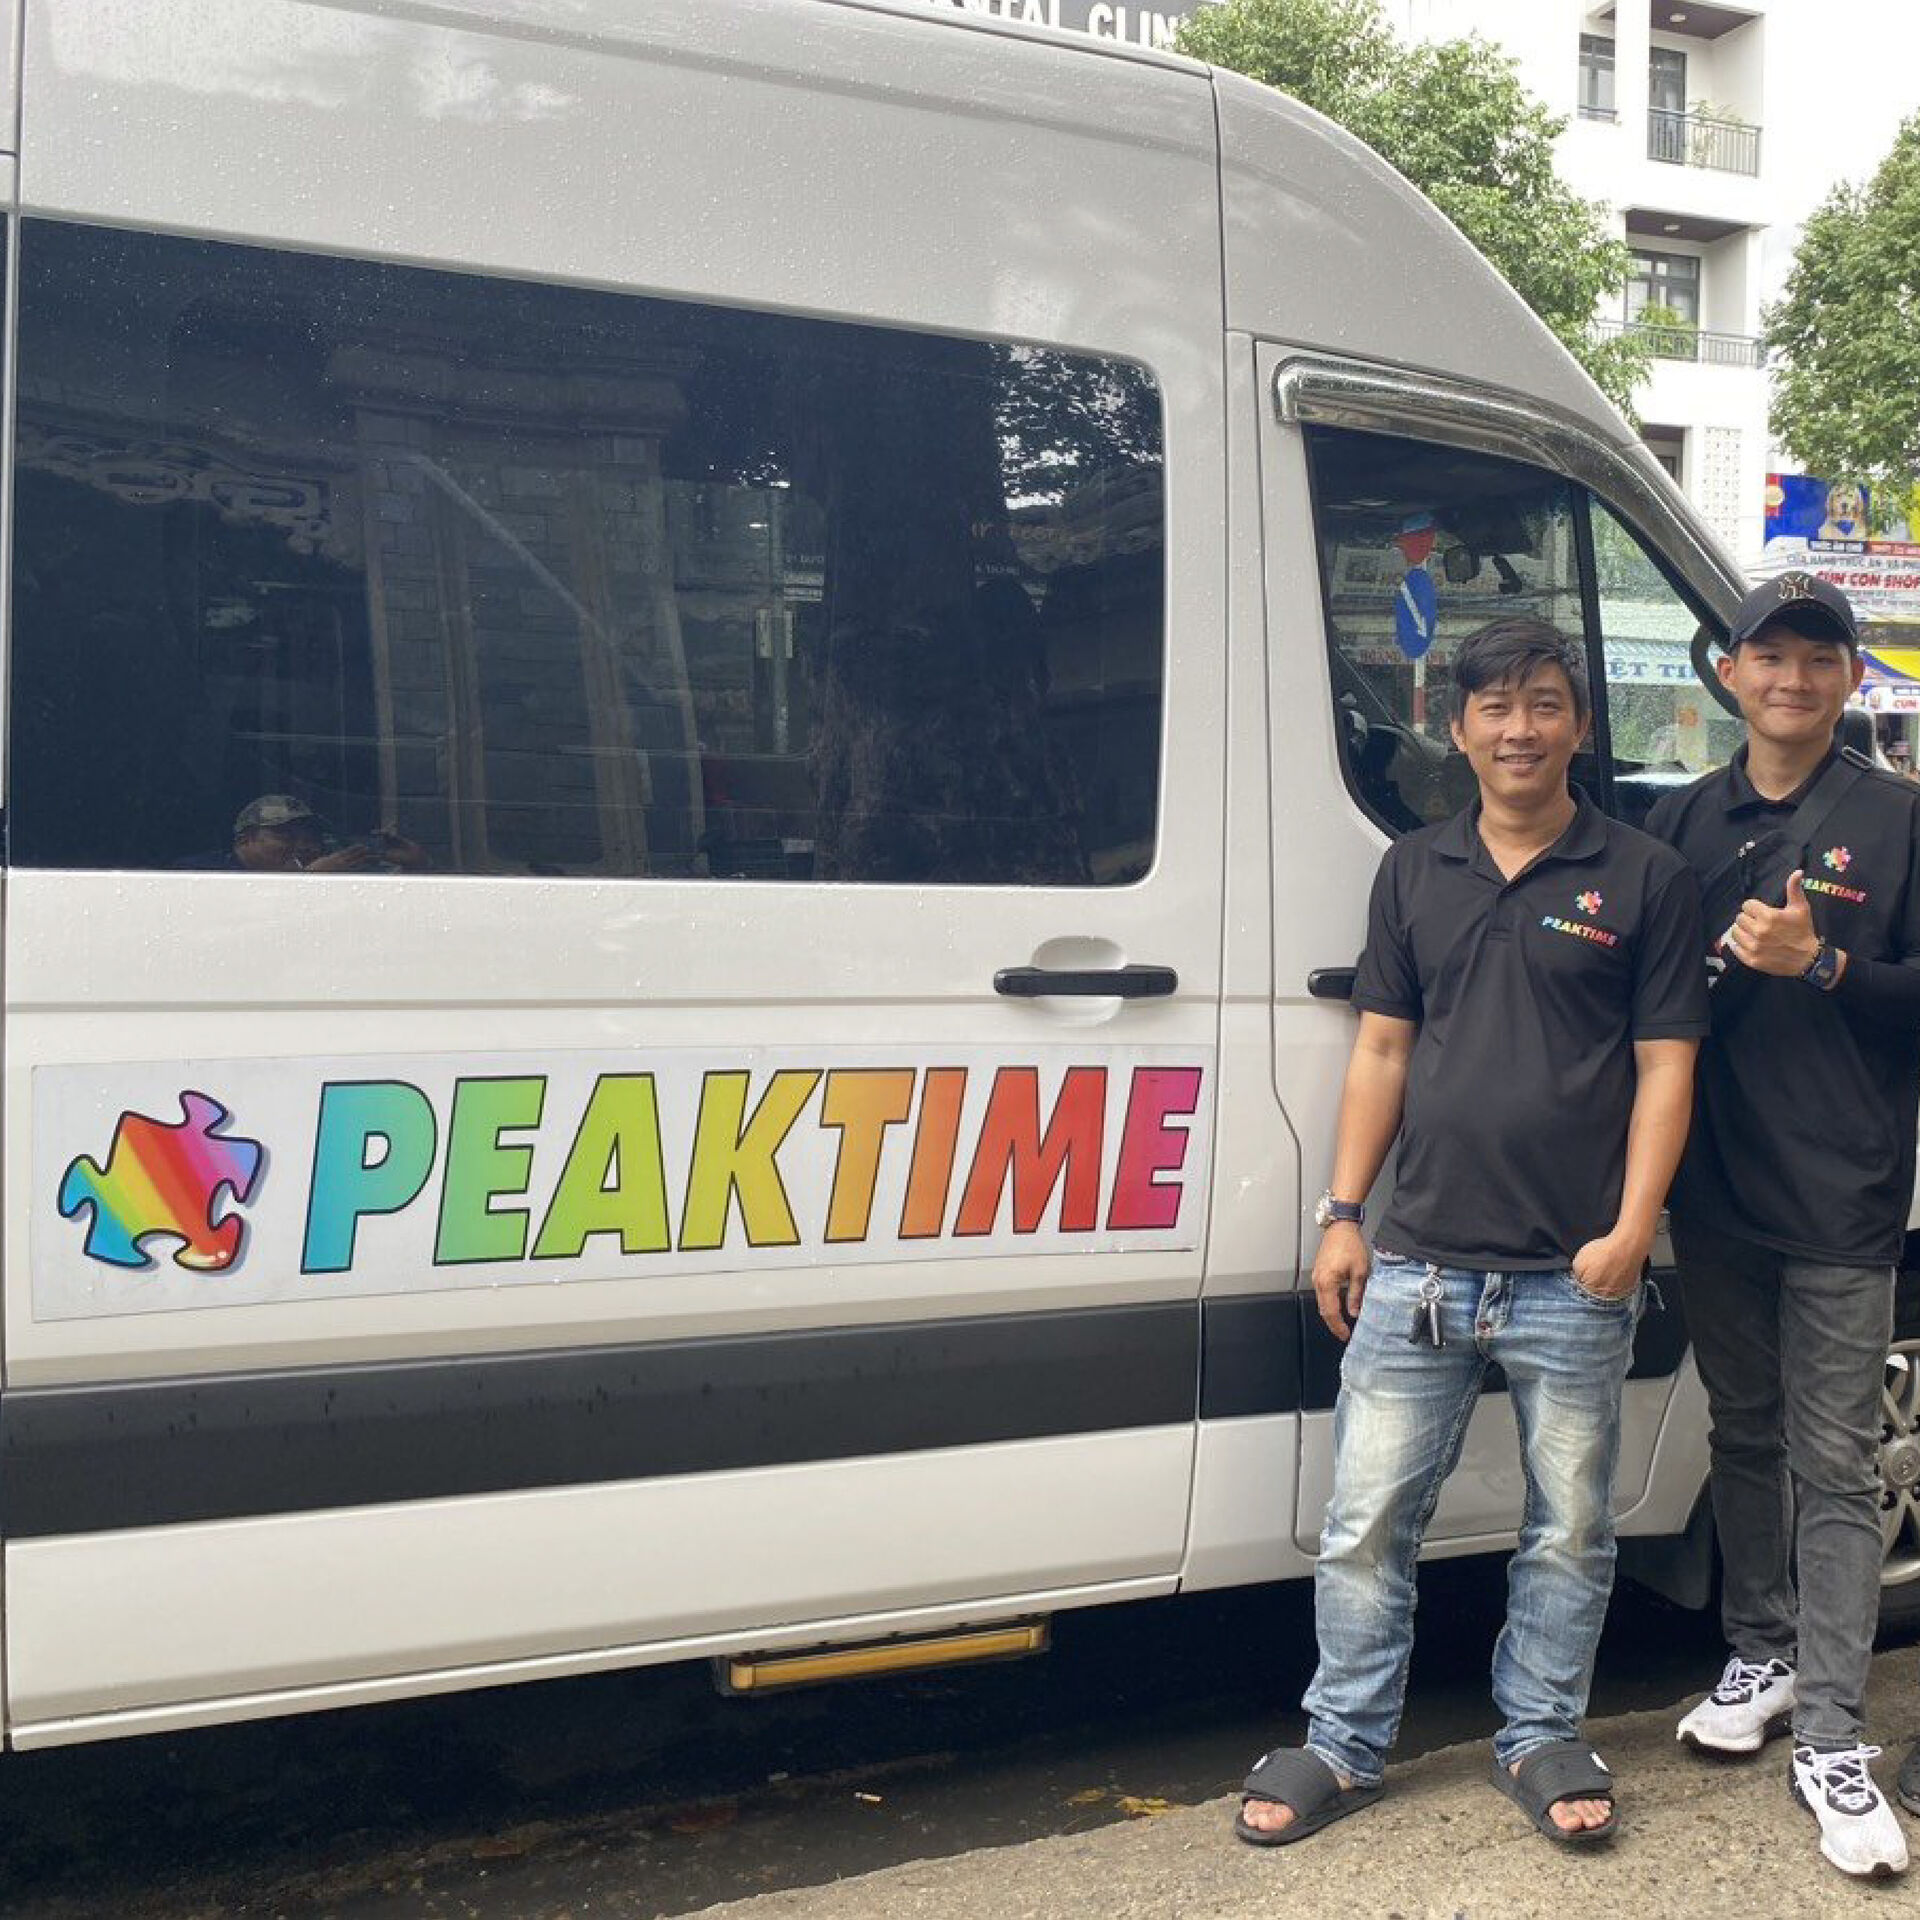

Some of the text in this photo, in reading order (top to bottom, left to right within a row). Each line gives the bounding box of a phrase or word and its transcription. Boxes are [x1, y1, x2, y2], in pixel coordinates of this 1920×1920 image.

[1802, 877, 1867, 903] EAKTIME
[1541, 915, 1618, 947] PEAKTIME
[301, 1065, 1203, 1275] PEAKTIME
